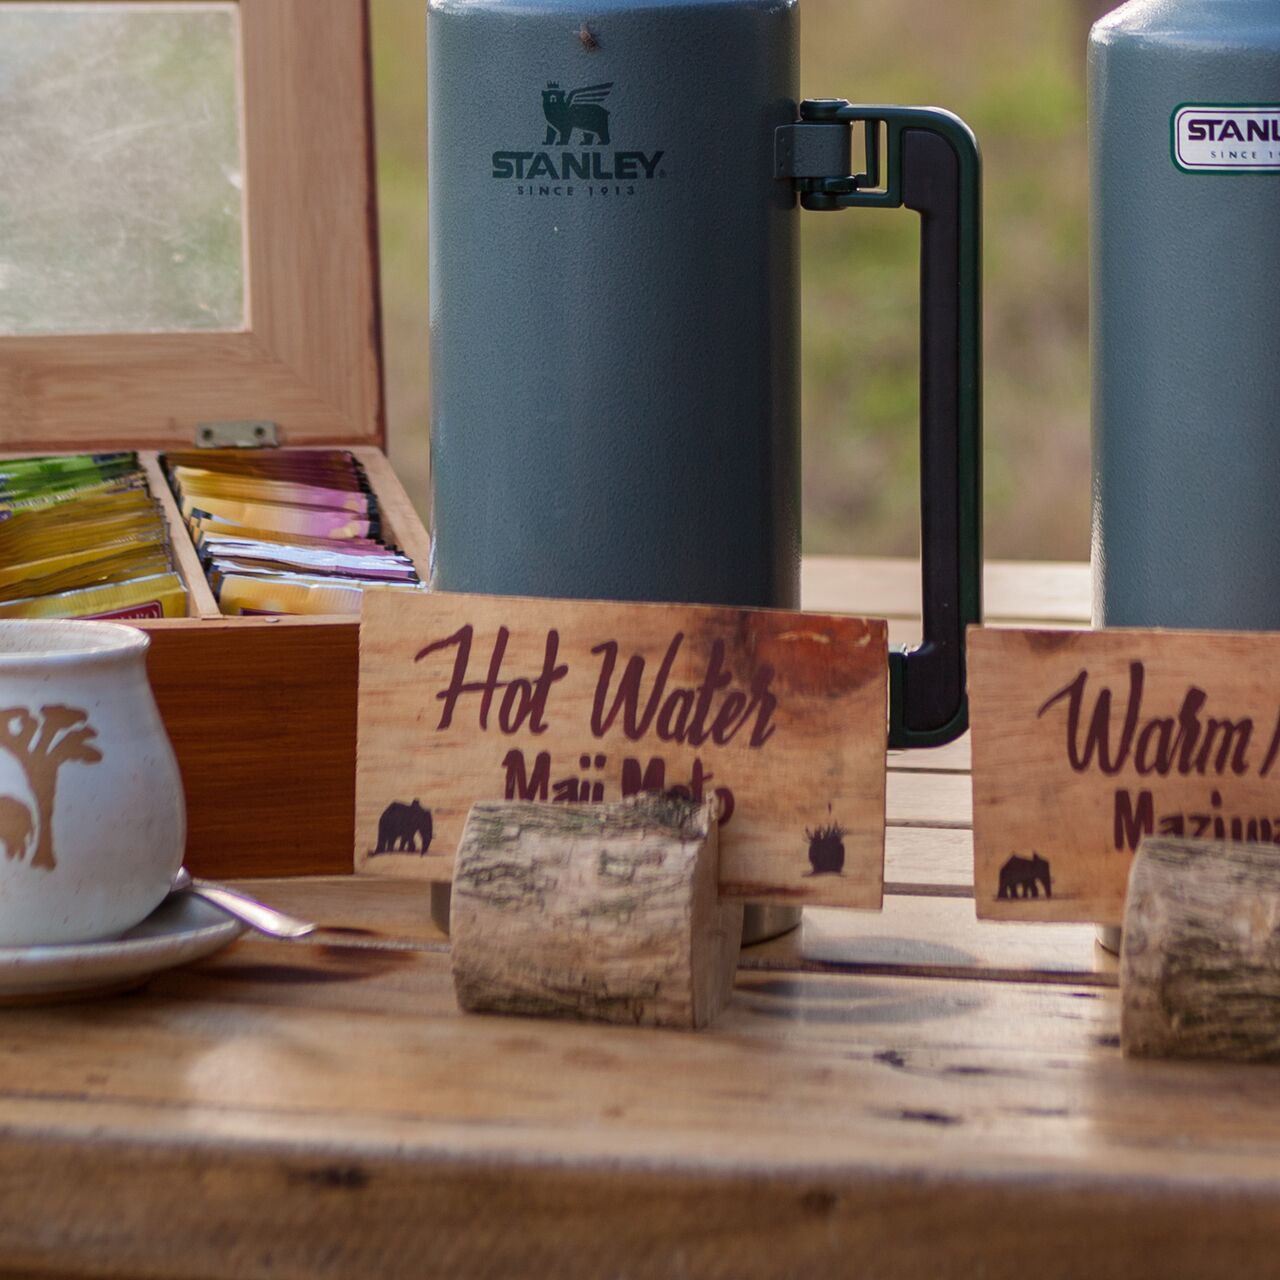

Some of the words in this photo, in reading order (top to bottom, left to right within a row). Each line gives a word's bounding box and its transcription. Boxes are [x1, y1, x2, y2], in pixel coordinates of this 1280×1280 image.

[491, 150, 665, 180] STANLEY
[1209, 150, 1257, 159] SINCE
[516, 185, 574, 197] SINCE
[588, 185, 636, 197] 1913
[413, 622, 570, 736] Hot
[590, 631, 779, 749] Water
[1036, 658, 1256, 777] Warm
